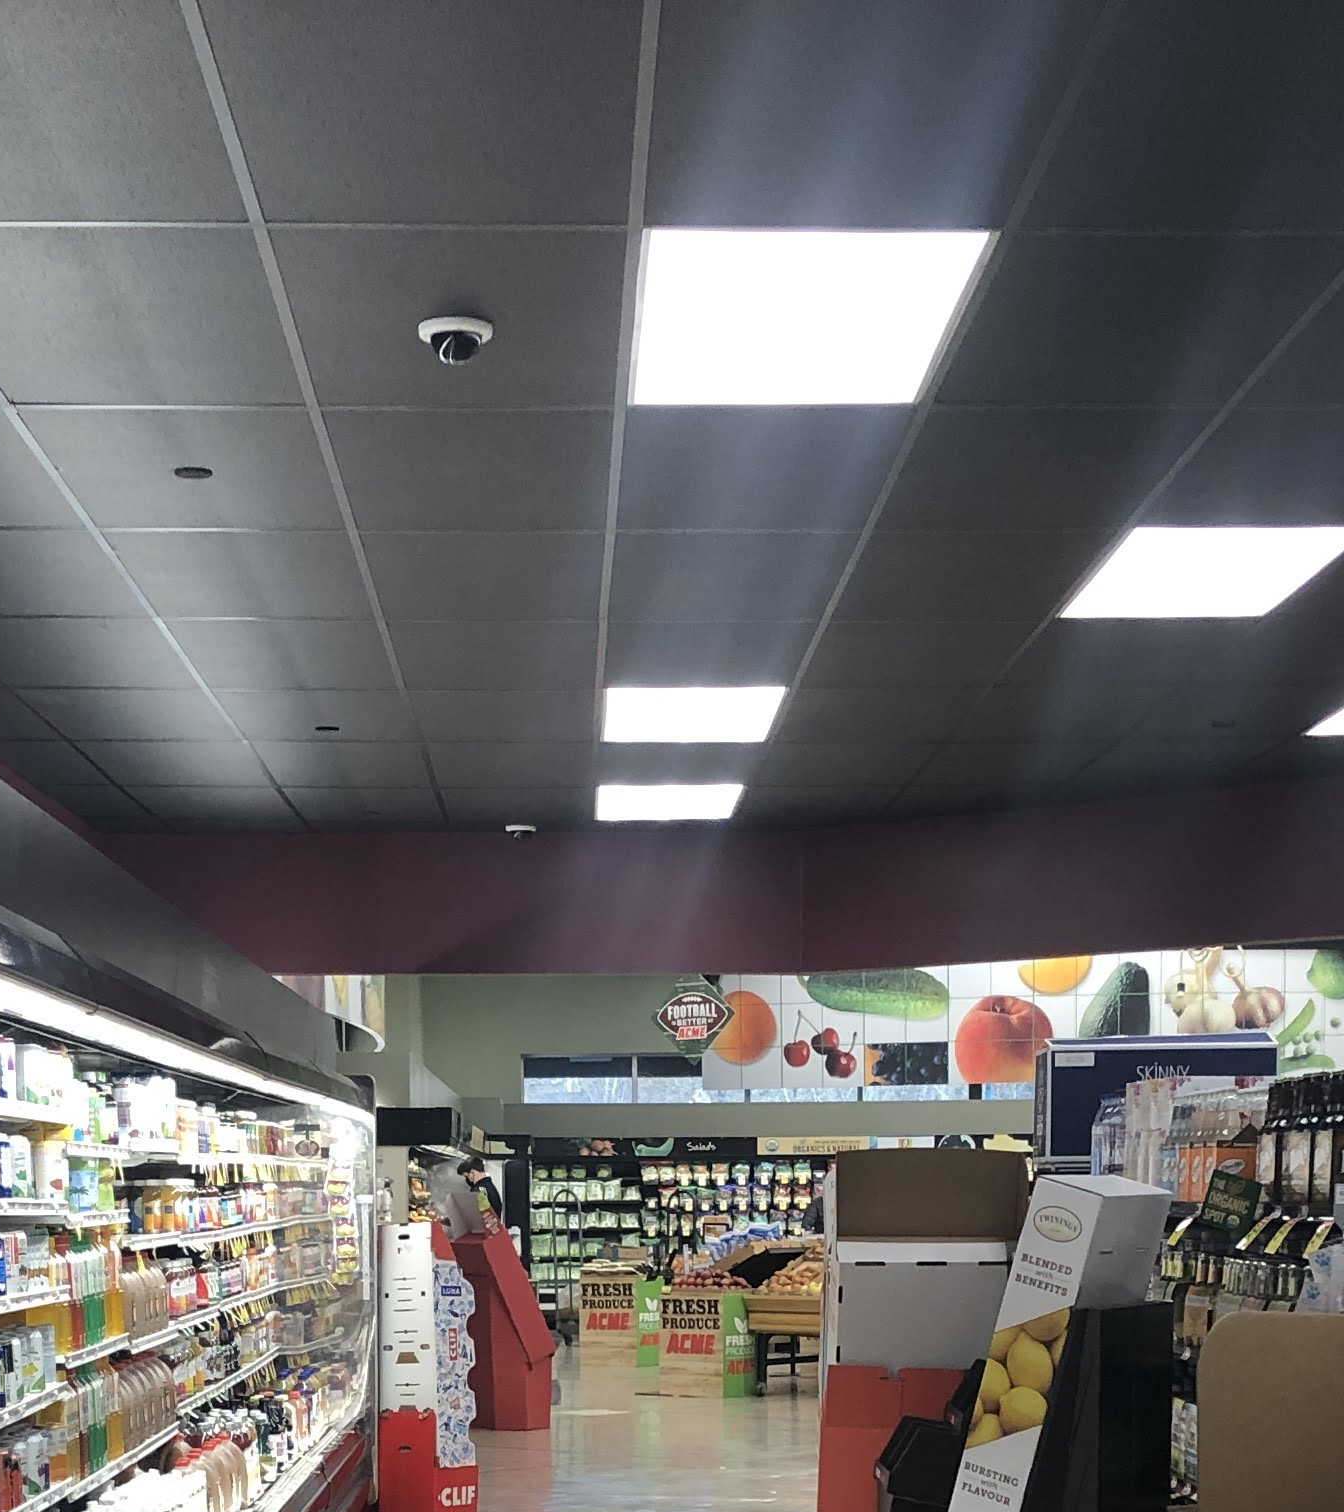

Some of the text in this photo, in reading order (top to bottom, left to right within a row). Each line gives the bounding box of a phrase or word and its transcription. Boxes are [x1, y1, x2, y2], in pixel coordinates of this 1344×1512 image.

[667, 1003, 717, 1020] FOOTBALL
[676, 1018, 707, 1027] BETTER
[677, 1026, 706, 1038] ACME
[1208, 1190, 1250, 1215] ORGANIC
[1038, 1214, 1078, 1234] TWININGS
[1202, 1207, 1227, 1225] SPOT
[1020, 1253, 1073, 1276] BLENDED
[1034, 1269, 1054, 1280] with
[580, 1282, 633, 1297] FRESH
[1014, 1273, 1068, 1296] BENEFITS
[581, 1299, 634, 1310] PRODUCE
[661, 1299, 720, 1315] FRESH
[585, 1312, 630, 1331] ACME
[662, 1317, 721, 1330] PRODUCE
[449, 1329, 457, 1360] CLIF
[666, 1333, 716, 1355] ACME
[963, 1461, 1019, 1487] BURSTING
[980, 1479, 998, 1490] with
[440, 1485, 476, 1507] CLIF
[961, 1481, 1011, 1507] FLAVOUR
